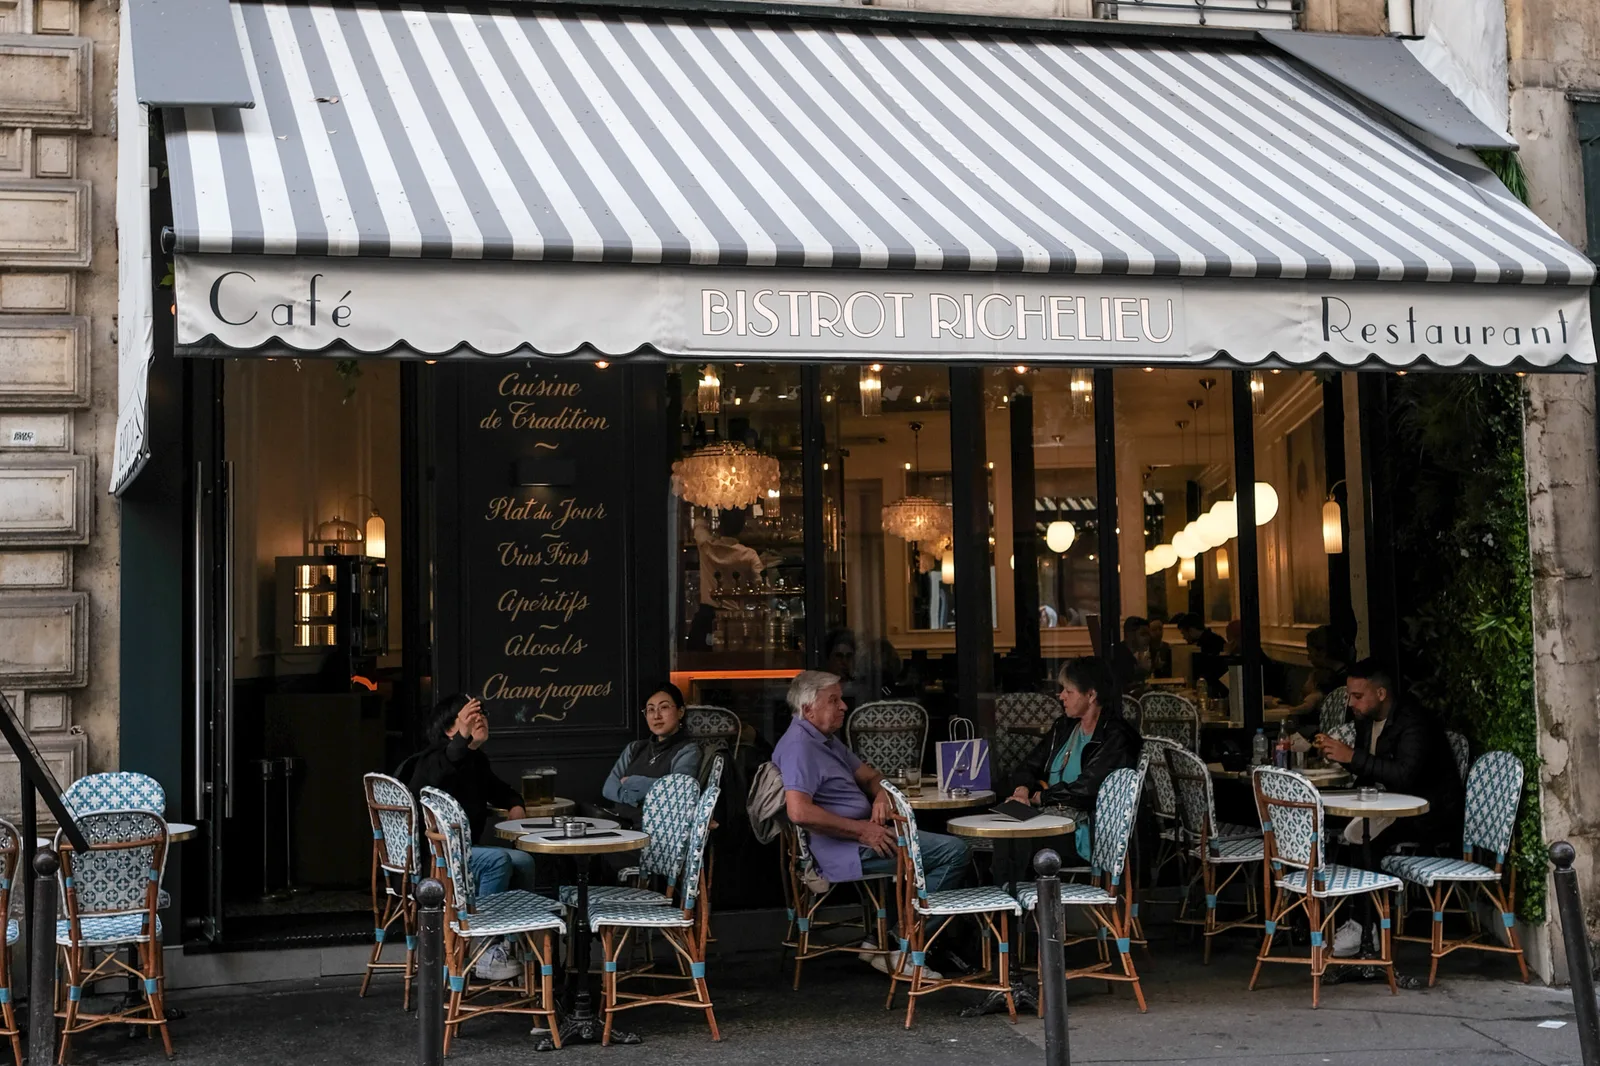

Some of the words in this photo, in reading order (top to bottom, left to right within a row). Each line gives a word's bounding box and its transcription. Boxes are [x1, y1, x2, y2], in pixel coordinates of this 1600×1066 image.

[209, 270, 352, 328] Café
[701, 288, 914, 338] BISTROT
[929, 292, 1174, 344] RICHELIEU
[1320, 296, 1569, 346] Restaurant
[498, 372, 582, 397] Cuisine
[479, 408, 502, 429] de
[508, 401, 610, 430] Tradition
[485, 496, 537, 521] Plat
[534, 503, 553, 520] du
[551, 497, 607, 530] Jour
[497, 541, 542, 567] Vins
[544, 541, 591, 566] Fins
[497, 589, 591, 622] Apéritifs
[504, 633, 588, 656] Alcools
[482, 673, 613, 710] Champagnes
